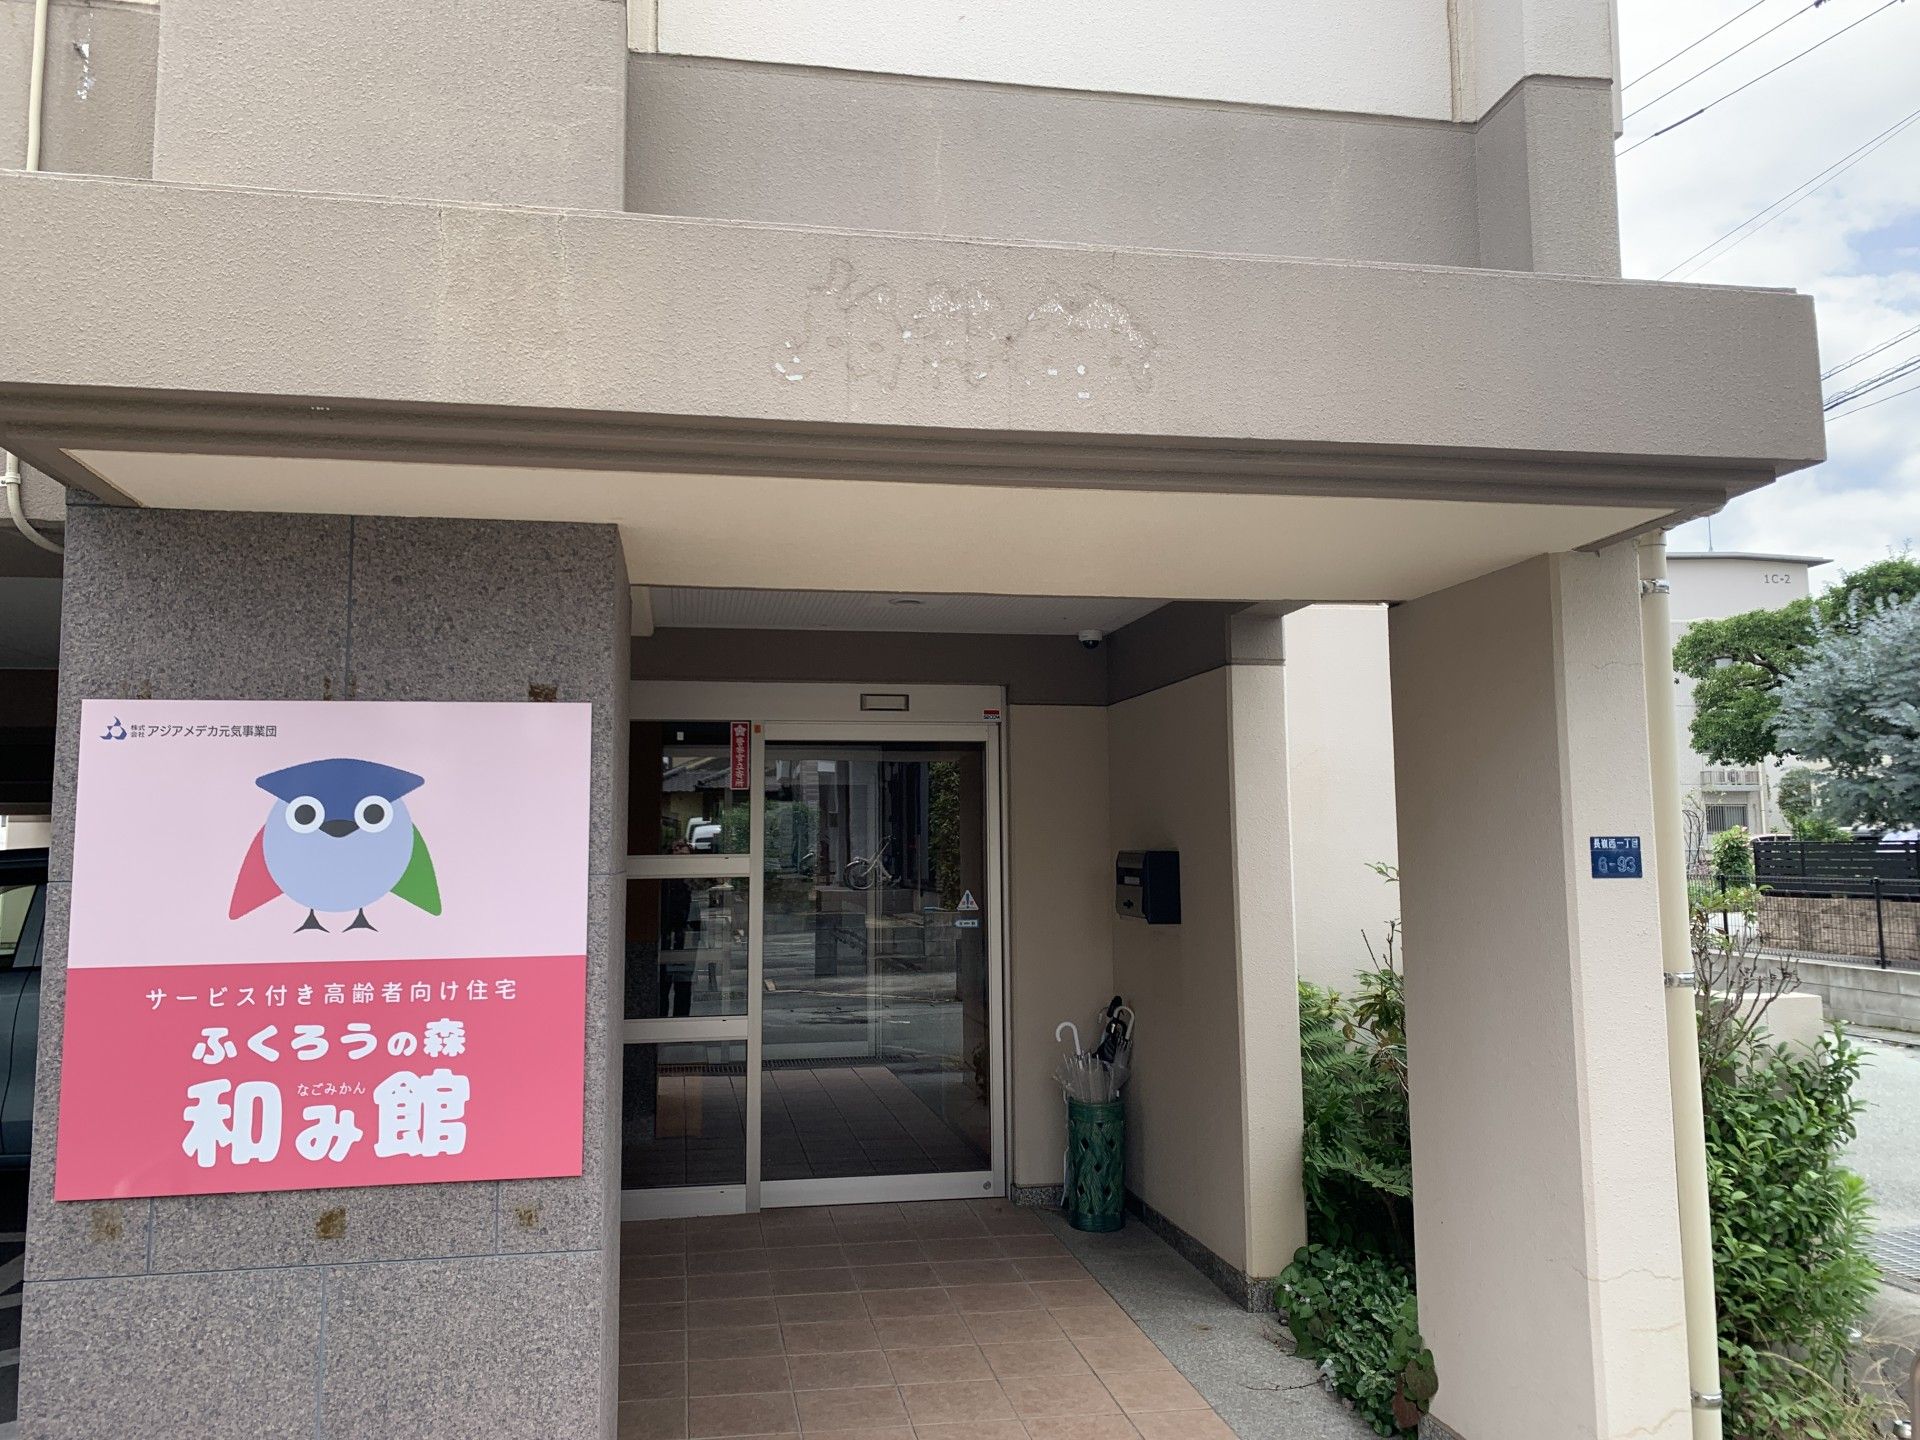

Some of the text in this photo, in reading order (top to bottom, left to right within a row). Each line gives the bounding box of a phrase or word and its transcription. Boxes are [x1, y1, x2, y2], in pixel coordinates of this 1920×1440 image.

[1764, 574, 1791, 584] 1C-2
[148, 725, 277, 738] アジアメデカ元気事業団
[1598, 856, 1636, 873] 6-93
[145, 978, 518, 1011] サービス付き高齢者向け住宅
[192, 1017, 466, 1064] ふくろうの森
[296, 1081, 367, 1097] なごみかん
[181, 1068, 470, 1168] 和み館
